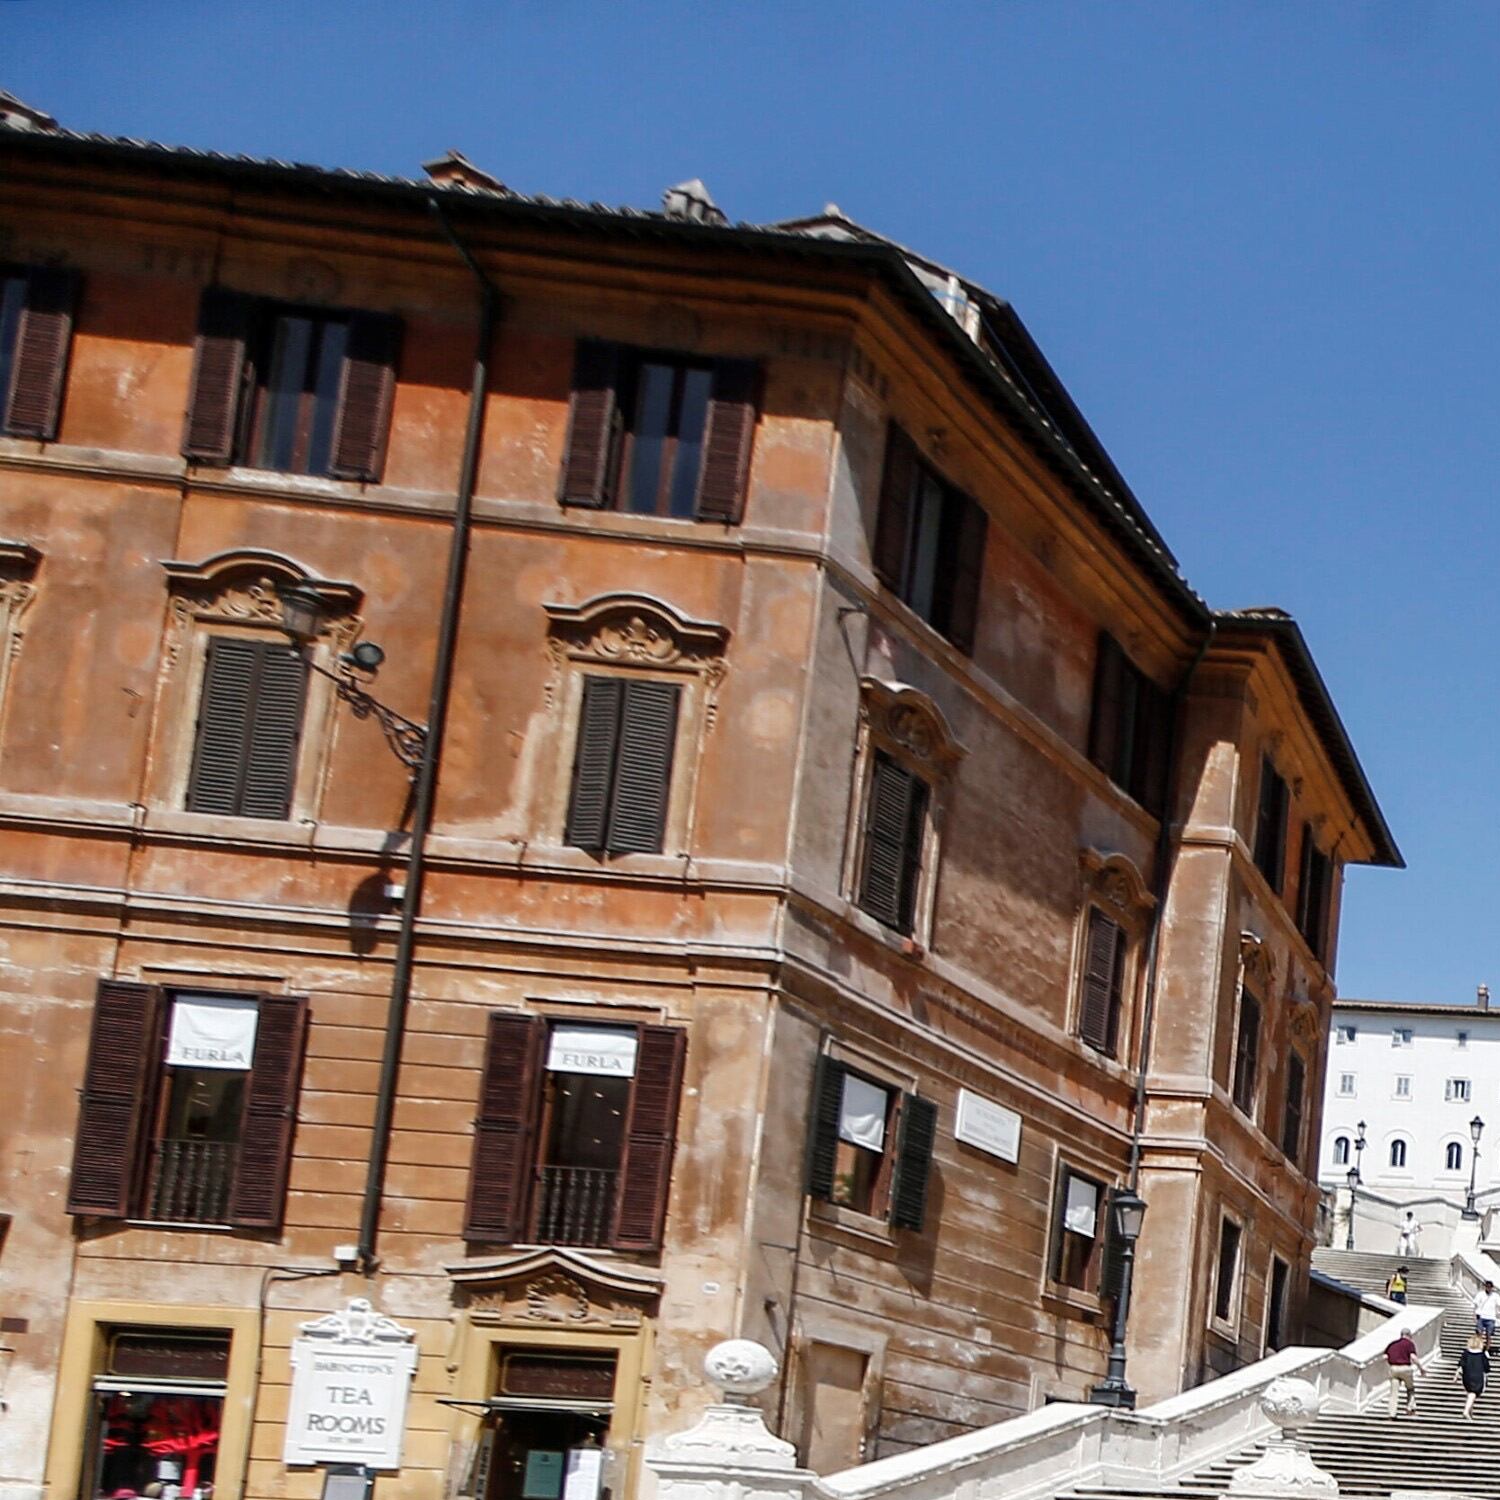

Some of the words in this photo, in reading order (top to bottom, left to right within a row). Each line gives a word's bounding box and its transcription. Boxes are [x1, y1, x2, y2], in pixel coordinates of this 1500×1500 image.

[182, 1046, 246, 1064] FURLA
[562, 1054, 624, 1070] FURLA
[326, 1386, 373, 1406] TEA
[306, 1412, 386, 1435] ROOMS
